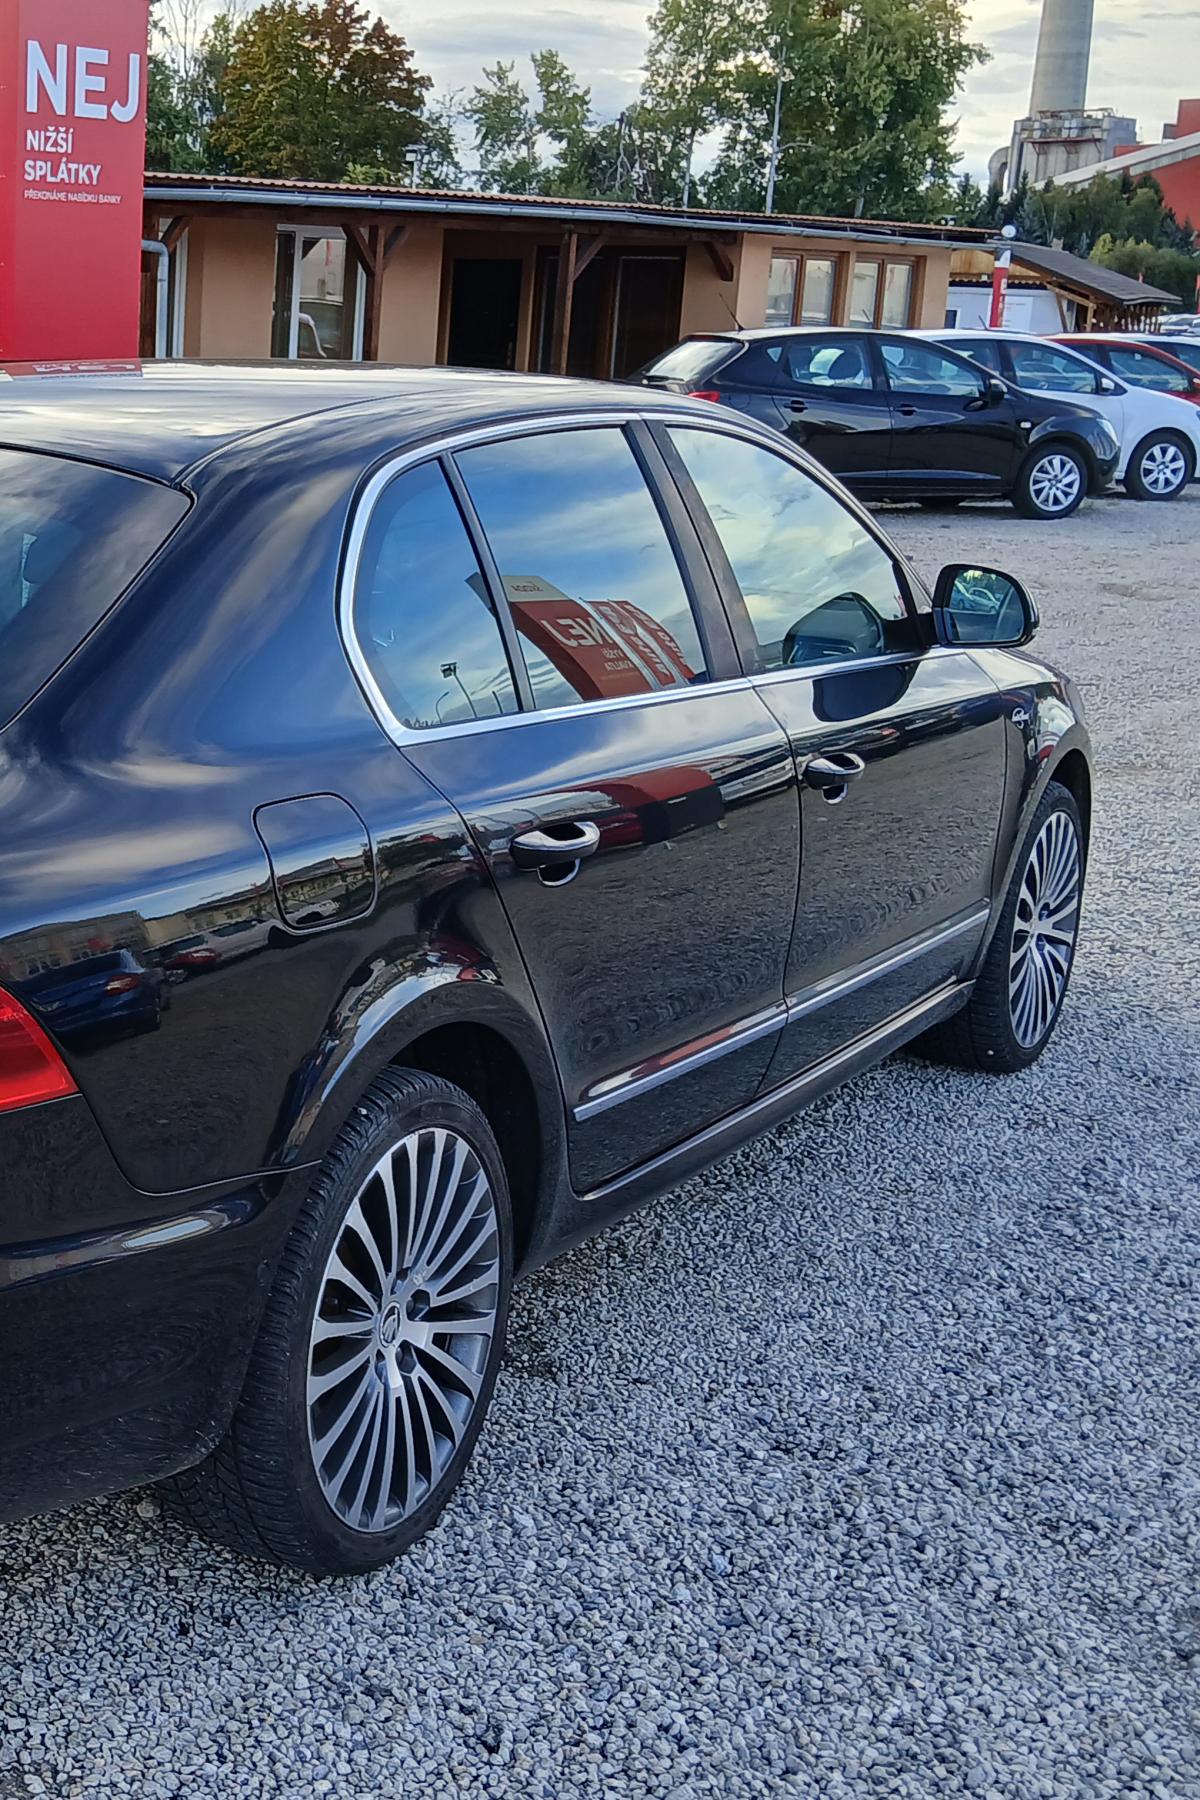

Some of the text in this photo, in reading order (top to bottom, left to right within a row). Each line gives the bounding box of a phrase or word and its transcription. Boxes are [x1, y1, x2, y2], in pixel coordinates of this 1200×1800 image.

[26, 40, 141, 123] NEJ
[26, 126, 74, 154] NIŽŠÍ
[24, 157, 102, 186] SPLÁTKY
